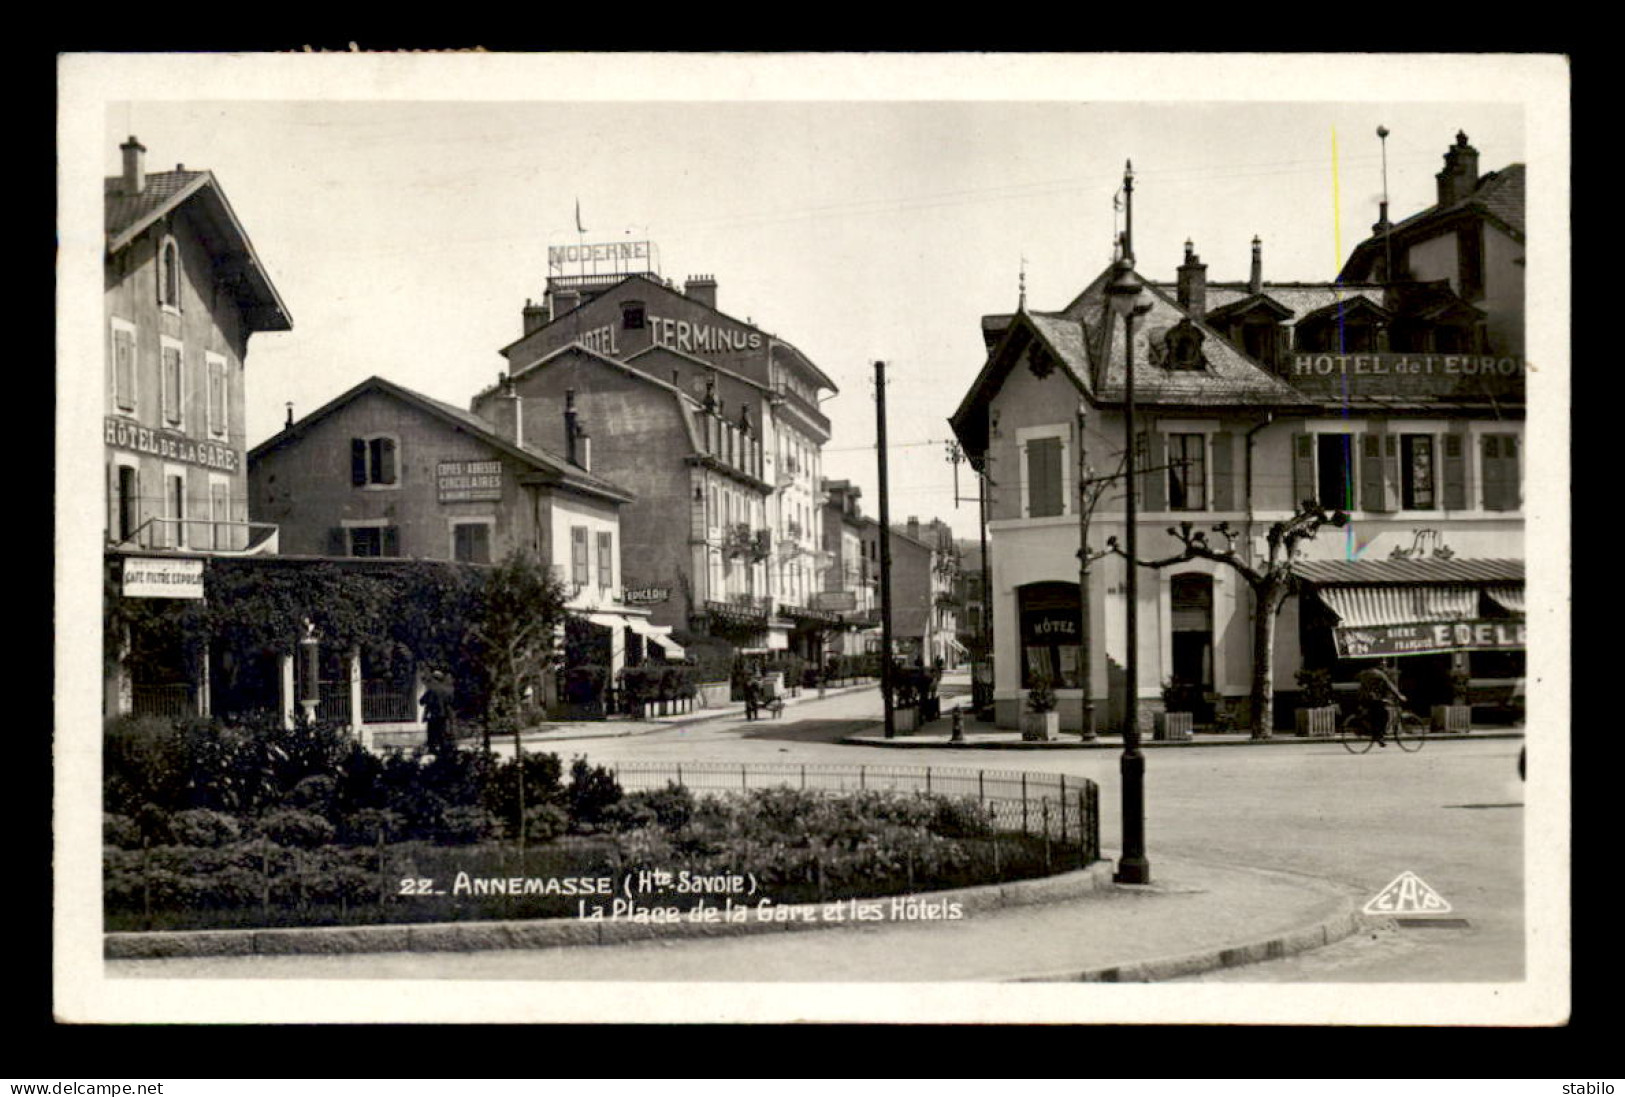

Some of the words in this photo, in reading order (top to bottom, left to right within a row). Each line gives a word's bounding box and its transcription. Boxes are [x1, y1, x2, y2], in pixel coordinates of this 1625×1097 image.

[549, 241, 649, 263] MODERNE
[648, 315, 763, 350] TERMINUS
[1396, 356, 1421, 374] de
[105, 419, 159, 454] HÔTEL
[161, 438, 177, 458] DE
[179, 443, 196, 461] LA
[438, 475, 501, 489] CIRCULAIRES
[1034, 616, 1075, 635] HÔTEL
